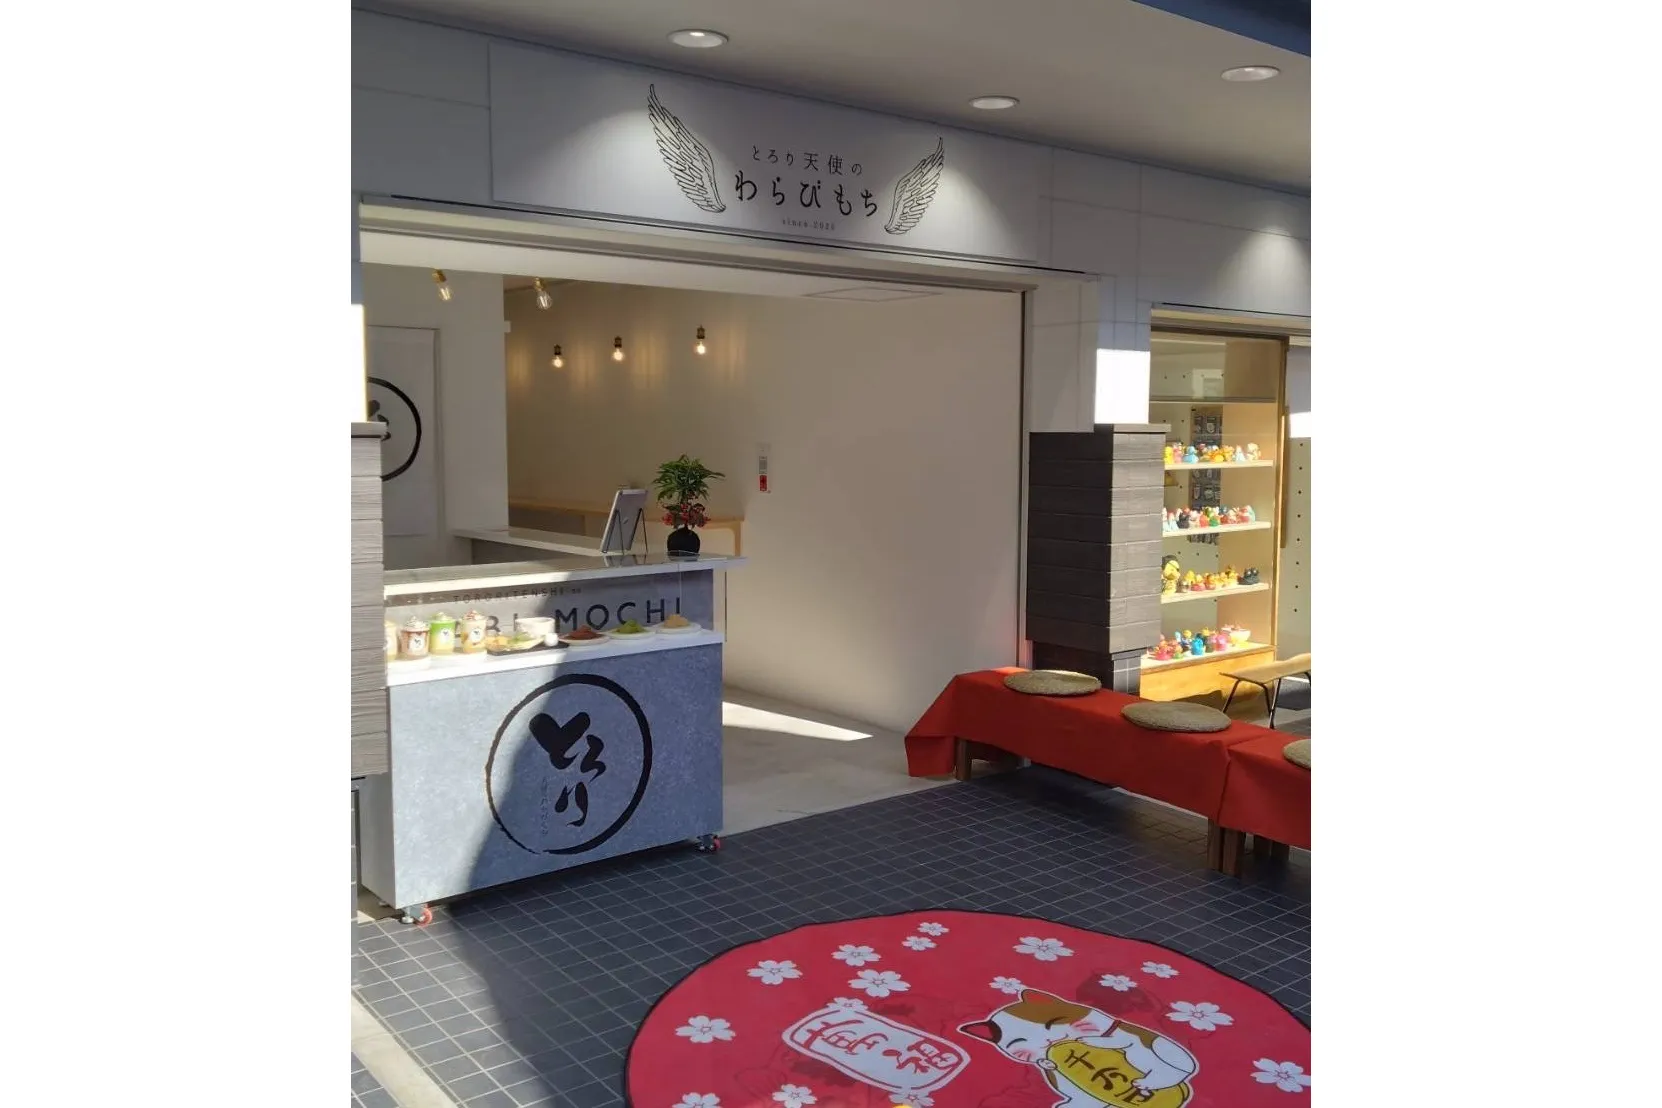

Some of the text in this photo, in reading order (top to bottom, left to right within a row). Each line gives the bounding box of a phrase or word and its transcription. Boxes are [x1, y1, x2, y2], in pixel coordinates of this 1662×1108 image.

[752, 145, 862, 176] とろり天使の
[735, 170, 878, 217] わらびもち
[554, 597, 680, 631] MOCHI
[529, 712, 607, 827] とろり
